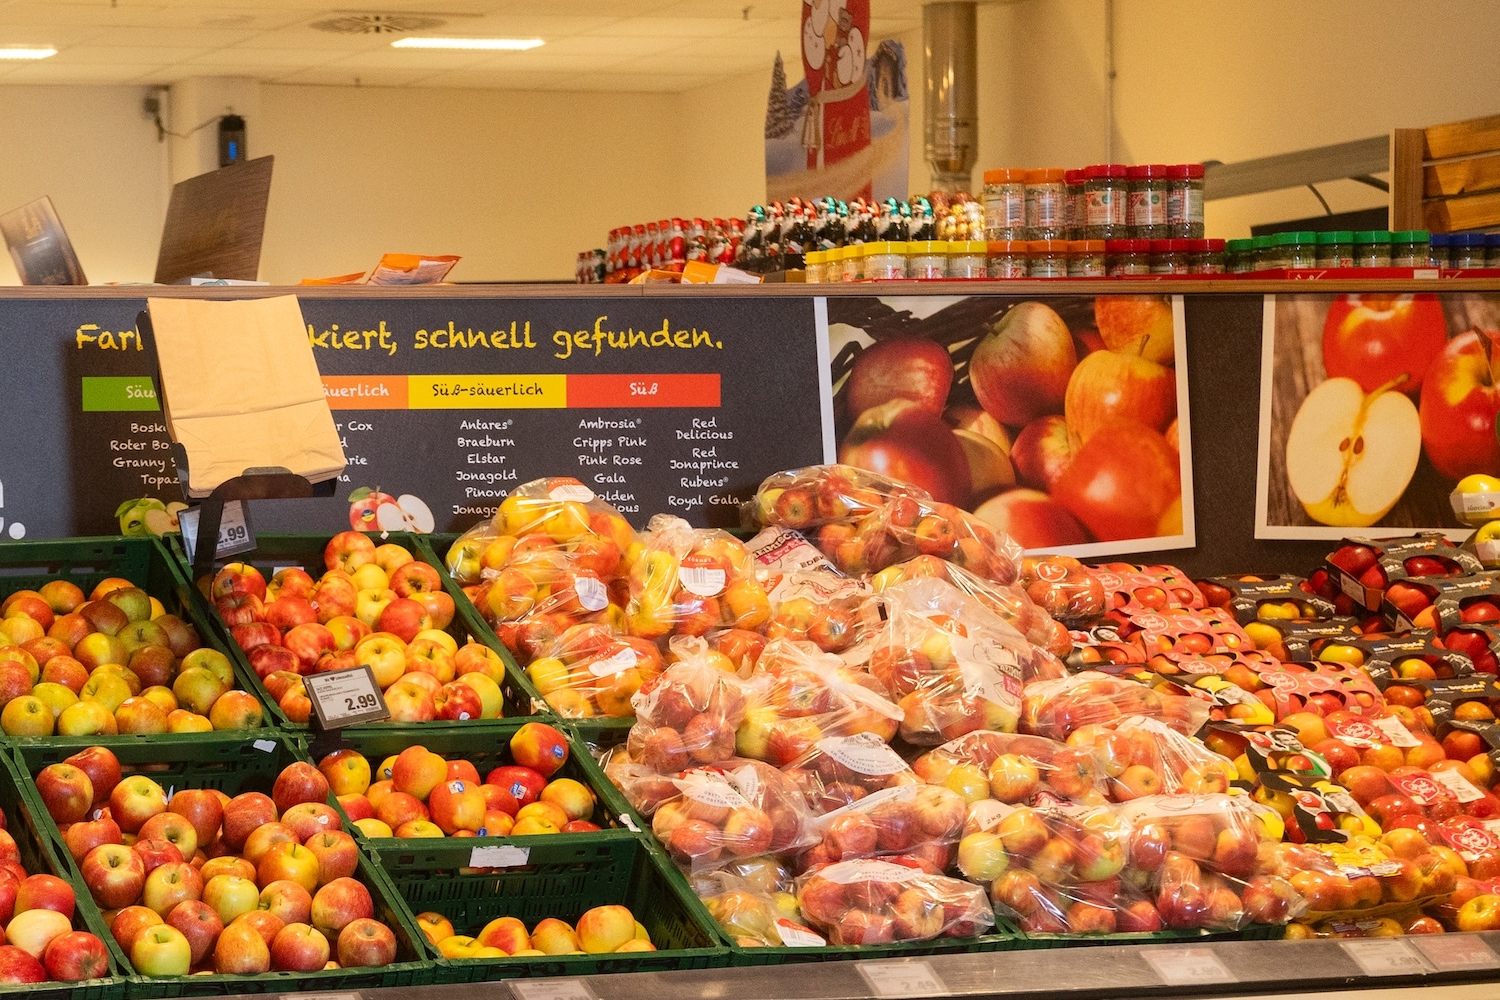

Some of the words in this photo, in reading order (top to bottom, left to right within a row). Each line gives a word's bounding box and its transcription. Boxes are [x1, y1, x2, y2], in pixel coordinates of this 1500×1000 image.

[308, 320, 397, 356] kiert,
[414, 321, 536, 349] schnell
[552, 315, 723, 359] gefunden.
[432, 382, 544, 397] Süß-säuerlich
[629, 381, 658, 396] Süß
[348, 421, 373, 431] Cox
[692, 416, 717, 428] Red
[675, 429, 734, 440] Delicious
[110, 439, 147, 451] Roter
[457, 435, 515, 447] Braeburn
[573, 437, 613, 452] Cripps
[618, 436, 647, 447] Pink
[692, 446, 717, 458] Red
[112, 457, 166, 472] Granny
[467, 453, 506, 464] Elstar
[578, 455, 608, 466] Pink
[613, 454, 642, 465] Rose
[670, 459, 739, 474] Jonaprince
[141, 474, 180, 490] Topaz
[456, 469, 517, 484] Jonagold
[594, 472, 626, 483] Gala
[465, 487, 508, 498] Pinova
[598, 490, 635, 501] olden
[668, 495, 703, 510] Royal
[708, 494, 740, 505] Gala
[453, 505, 498, 517] Jonago
[344, 693, 377, 711] 2.99
